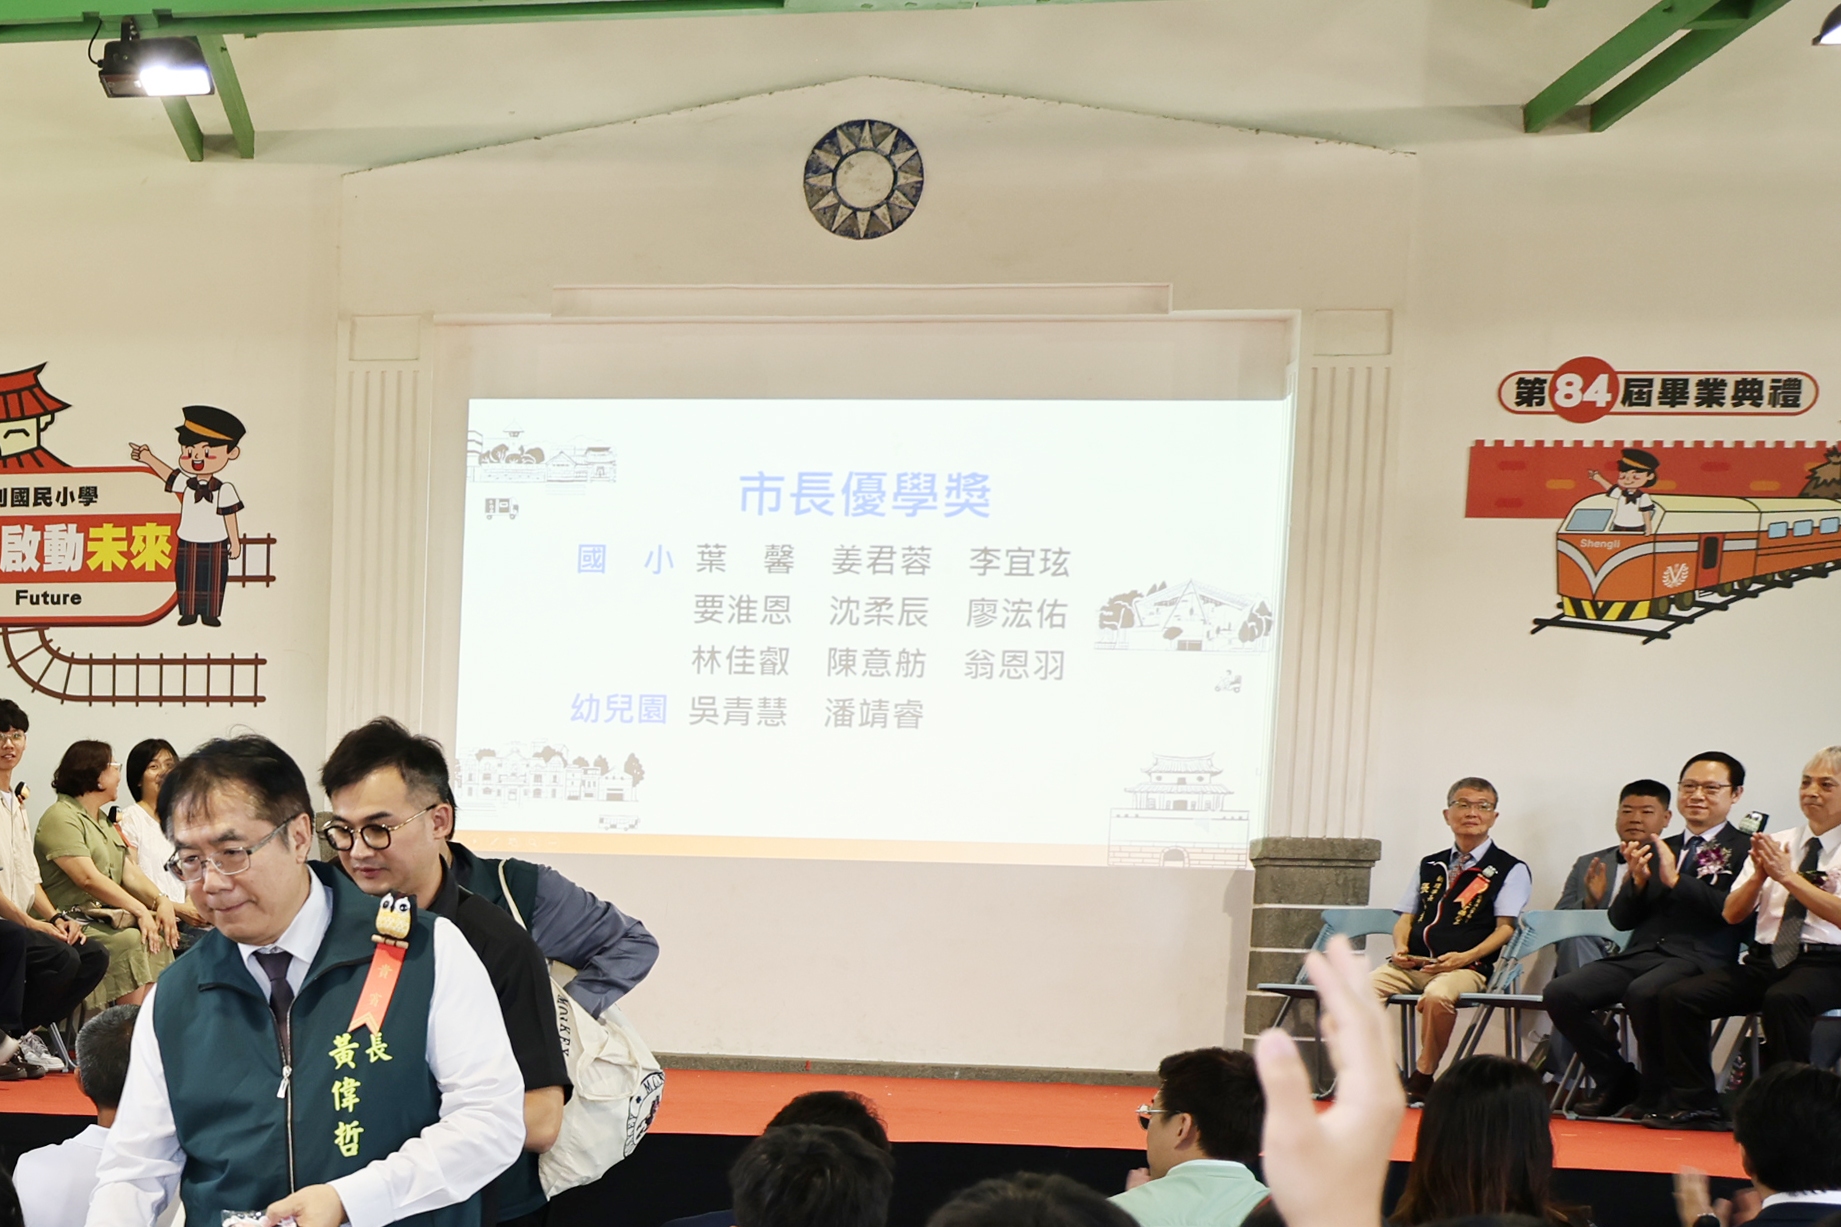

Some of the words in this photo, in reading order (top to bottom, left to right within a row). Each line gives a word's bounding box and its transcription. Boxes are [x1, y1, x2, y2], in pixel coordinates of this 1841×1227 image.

[1514, 371, 1803, 410] 第84屆畢業典禮
[738, 470, 993, 520] 市長優學獎
[0, 521, 173, 574] 啟動未來
[696, 542, 727, 574] 葉
[763, 542, 795, 576] 馨
[831, 543, 933, 577] 姜君蓉
[968, 545, 1072, 578] 李宜玹
[1579, 538, 1621, 550] Shengli
[15, 589, 82, 606] Future
[693, 593, 792, 626] 要淮恩
[828, 594, 930, 628] 沈柔辰
[965, 596, 1069, 630] 廖浤佑
[690, 643, 791, 677] 林佳叡
[826, 646, 928, 680] 陳意舫
[963, 648, 1066, 682] 翁恩羽
[569, 692, 668, 725] 幼兒園
[688, 694, 788, 728] 吳青慧
[823, 696, 924, 730] 潘靖睿
[328, 1032, 365, 1158] 黃偉哲
